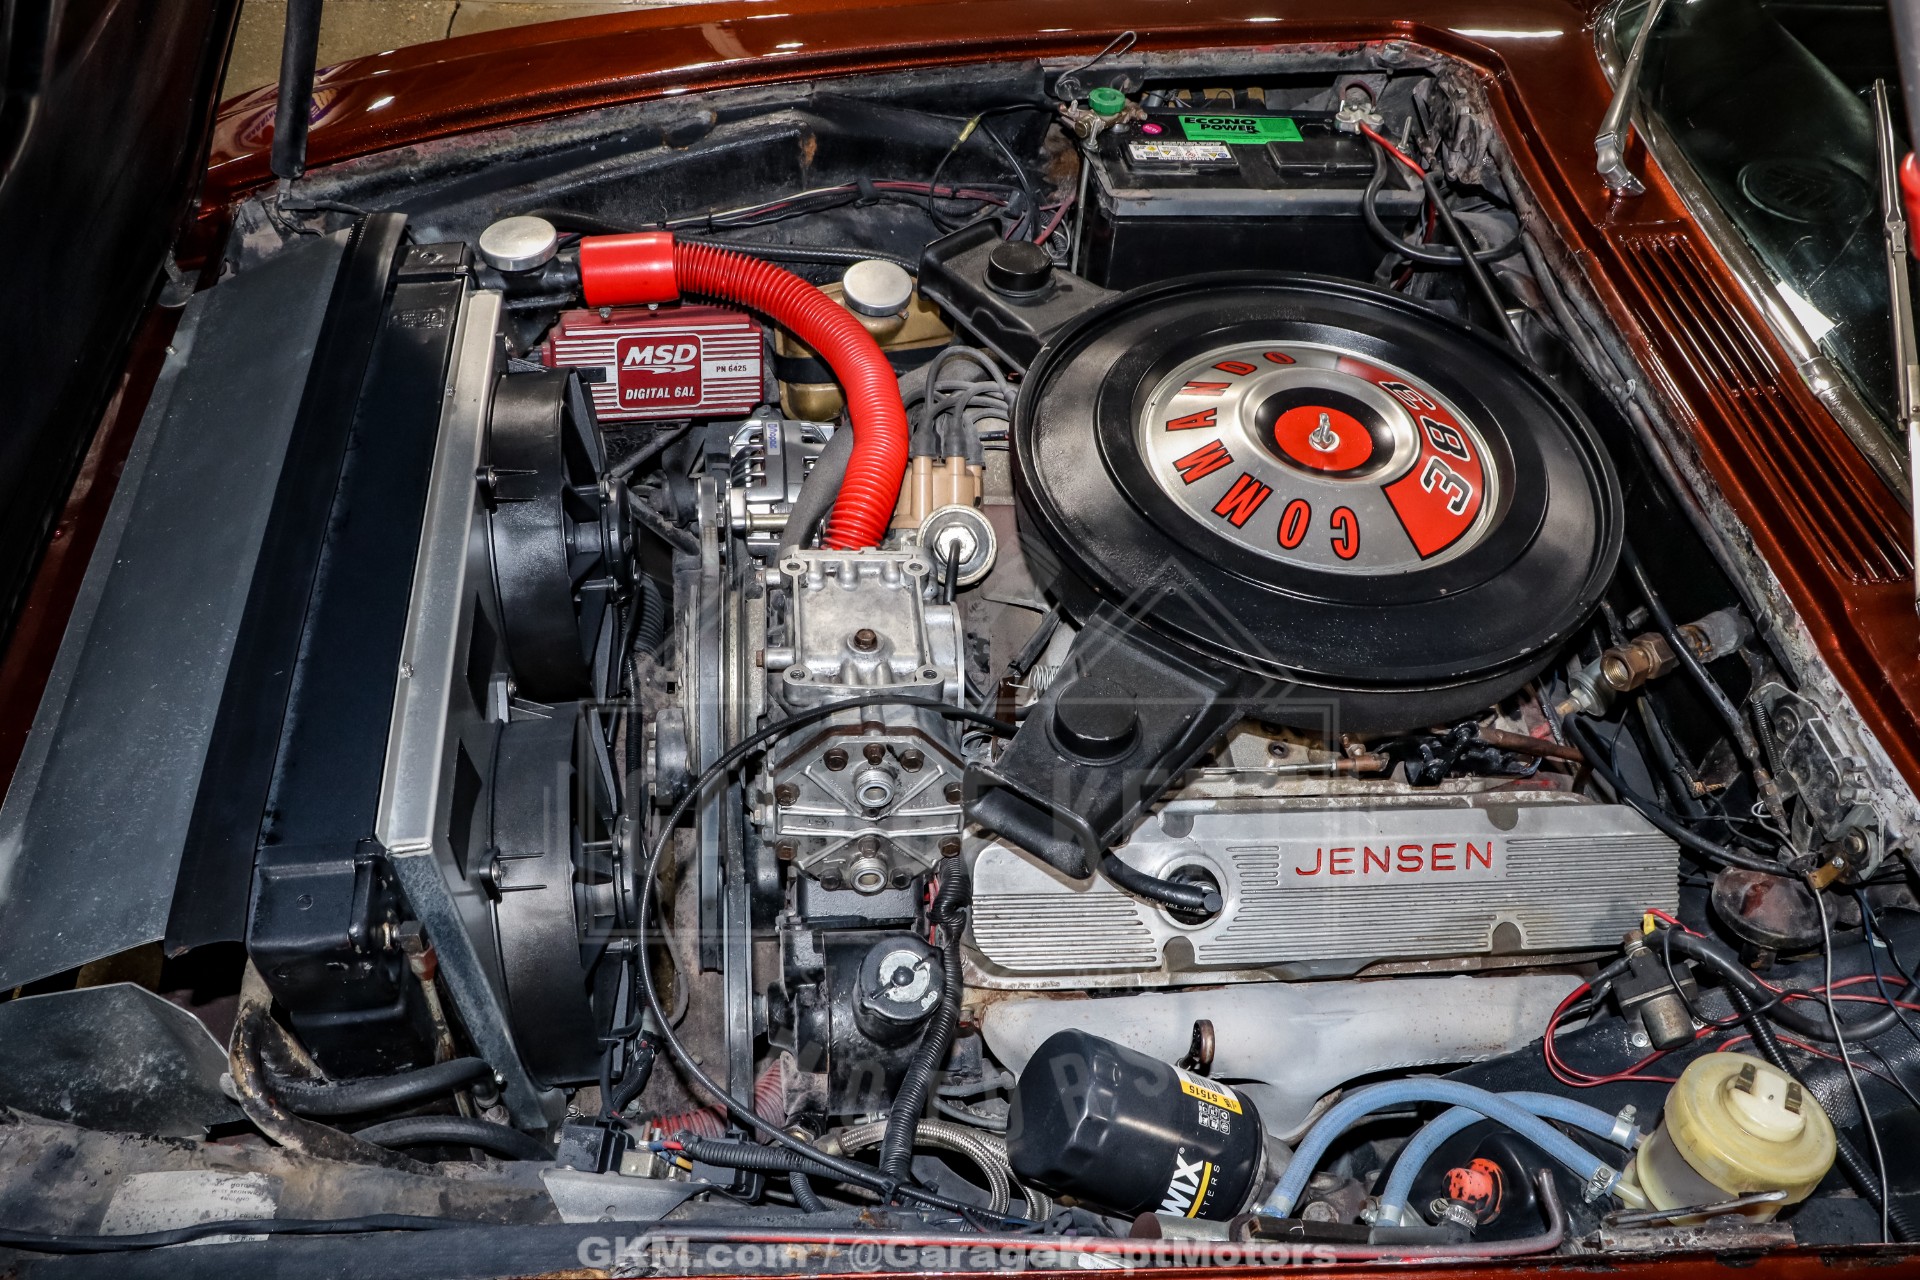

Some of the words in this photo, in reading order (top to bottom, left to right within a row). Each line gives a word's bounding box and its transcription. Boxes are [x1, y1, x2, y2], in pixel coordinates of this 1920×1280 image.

[1184, 117, 1257, 125] ECONO
[1200, 123, 1260, 132] POWER
[623, 344, 698, 366] MSD
[716, 365, 727, 373] PN
[728, 364, 747, 372] 6425
[625, 387, 671, 400] DIGITAL
[674, 386, 696, 398] 6AL
[1166, 352, 1361, 561] COMMANDO
[1378, 380, 1473, 516] 383
[1295, 841, 1494, 876] JENSEN
[1189, 1085, 1218, 1103] 51515
[1154, 1153, 1204, 1217] WIX
[1198, 1164, 1220, 1217] LTERS
